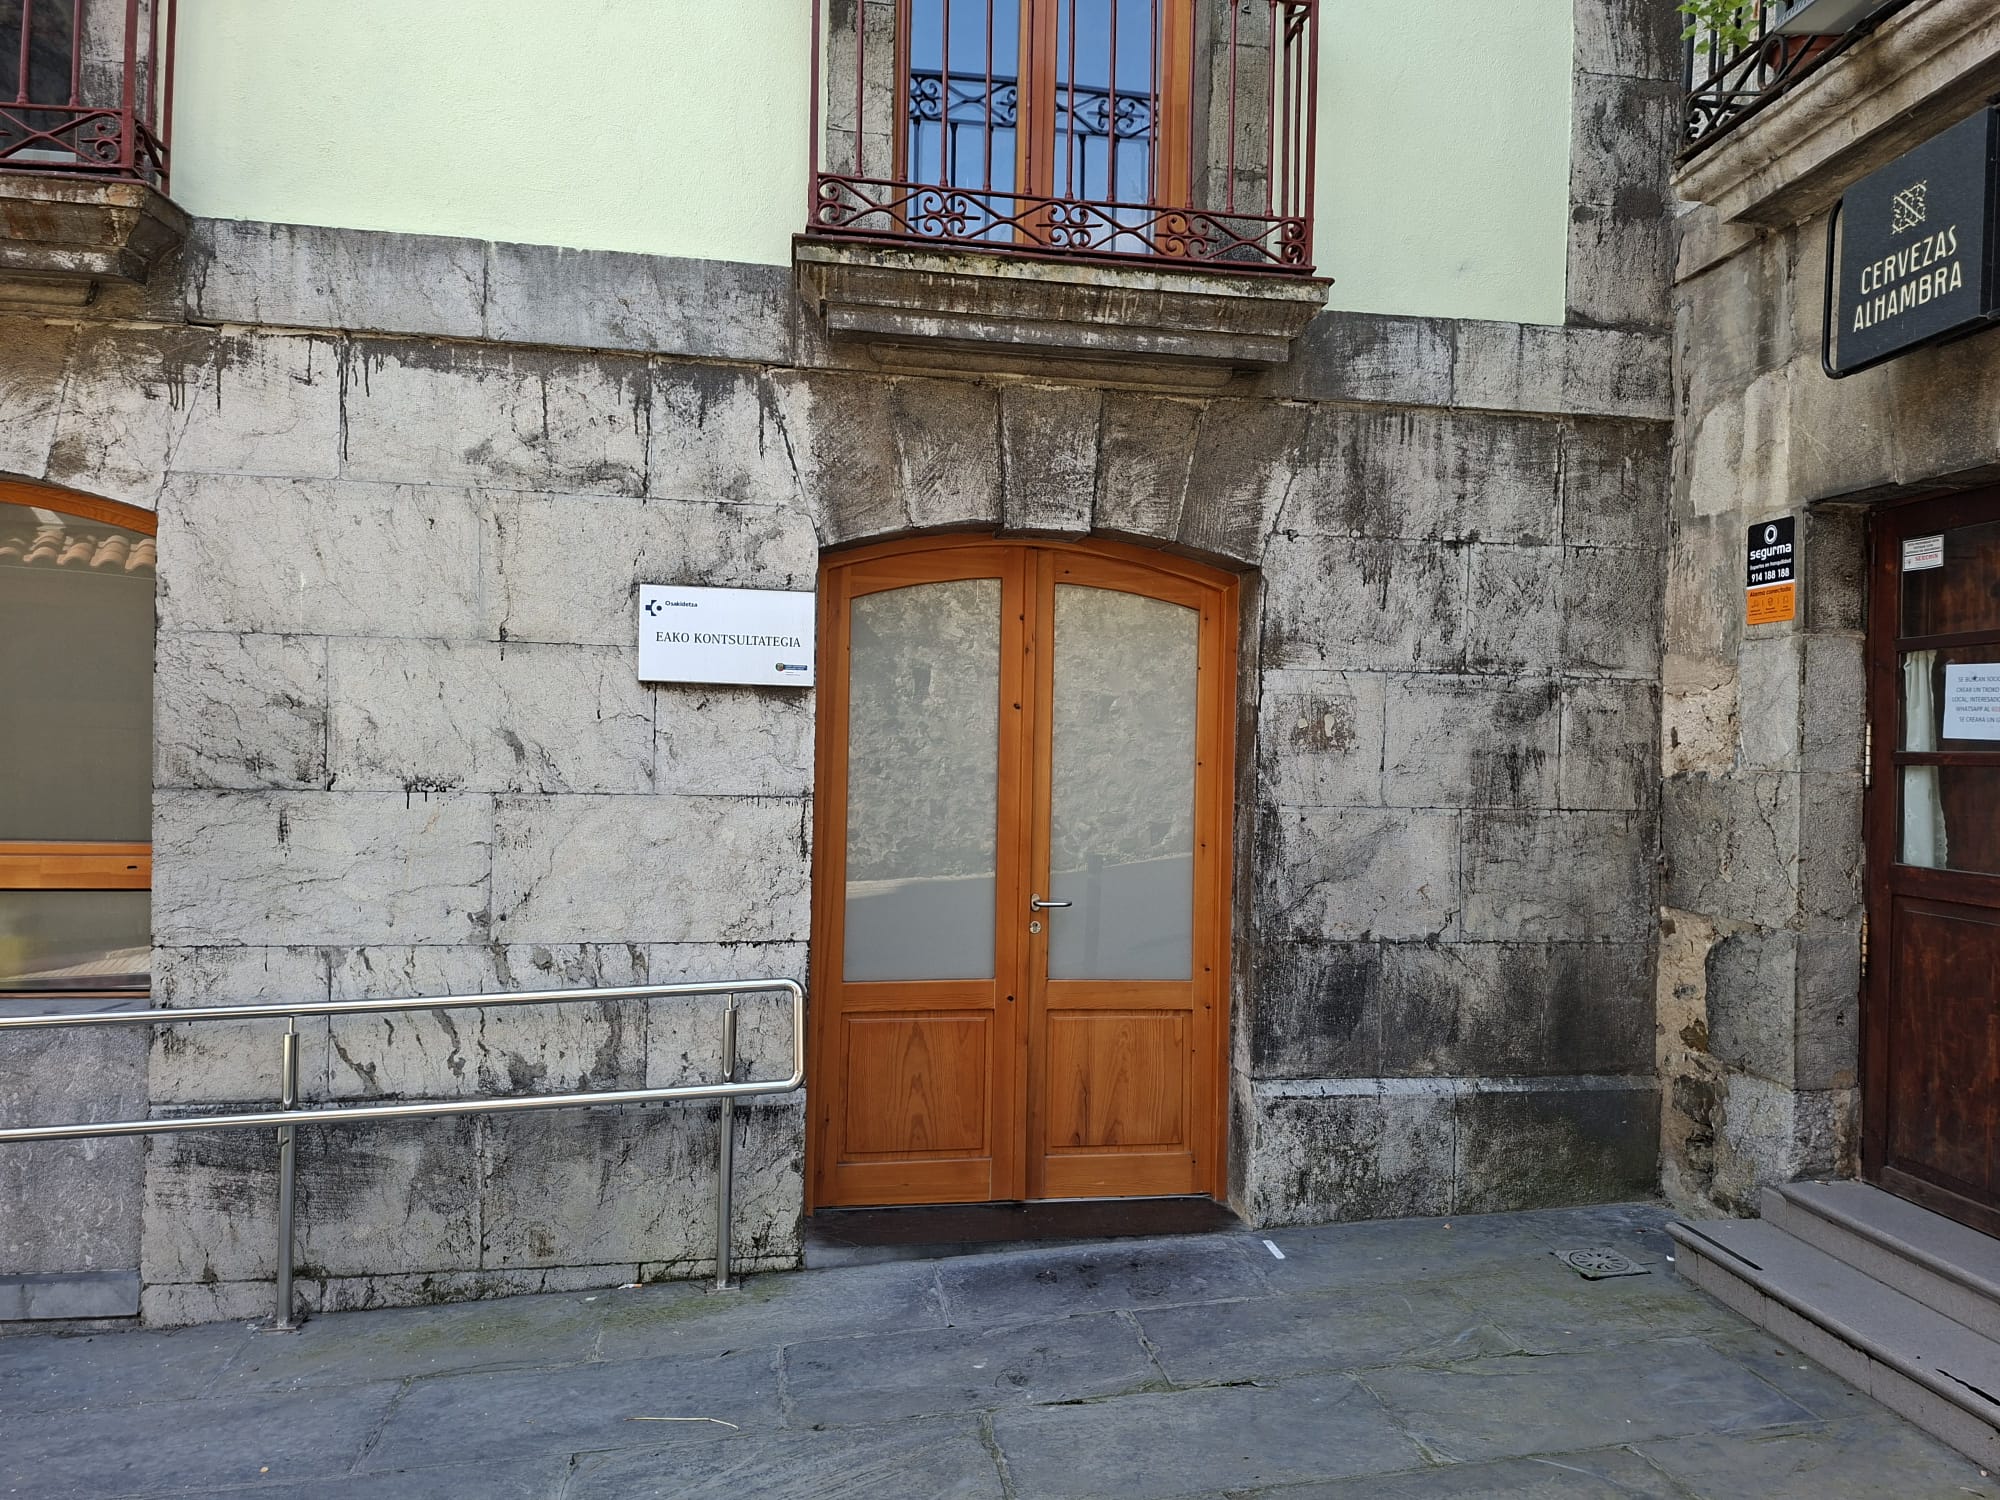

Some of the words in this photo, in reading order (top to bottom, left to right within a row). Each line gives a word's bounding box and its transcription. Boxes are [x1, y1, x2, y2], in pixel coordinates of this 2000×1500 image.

[1861, 224, 1957, 295] CERVEZAS
[1853, 260, 1962, 332] ALHAMBRA
[1750, 543, 1792, 561] segurma
[1751, 572, 1763, 583] 914
[665, 600, 698, 608] Osakidetza
[656, 631, 690, 643] EAKO
[694, 633, 801, 648] KONTSULTATEGIA
